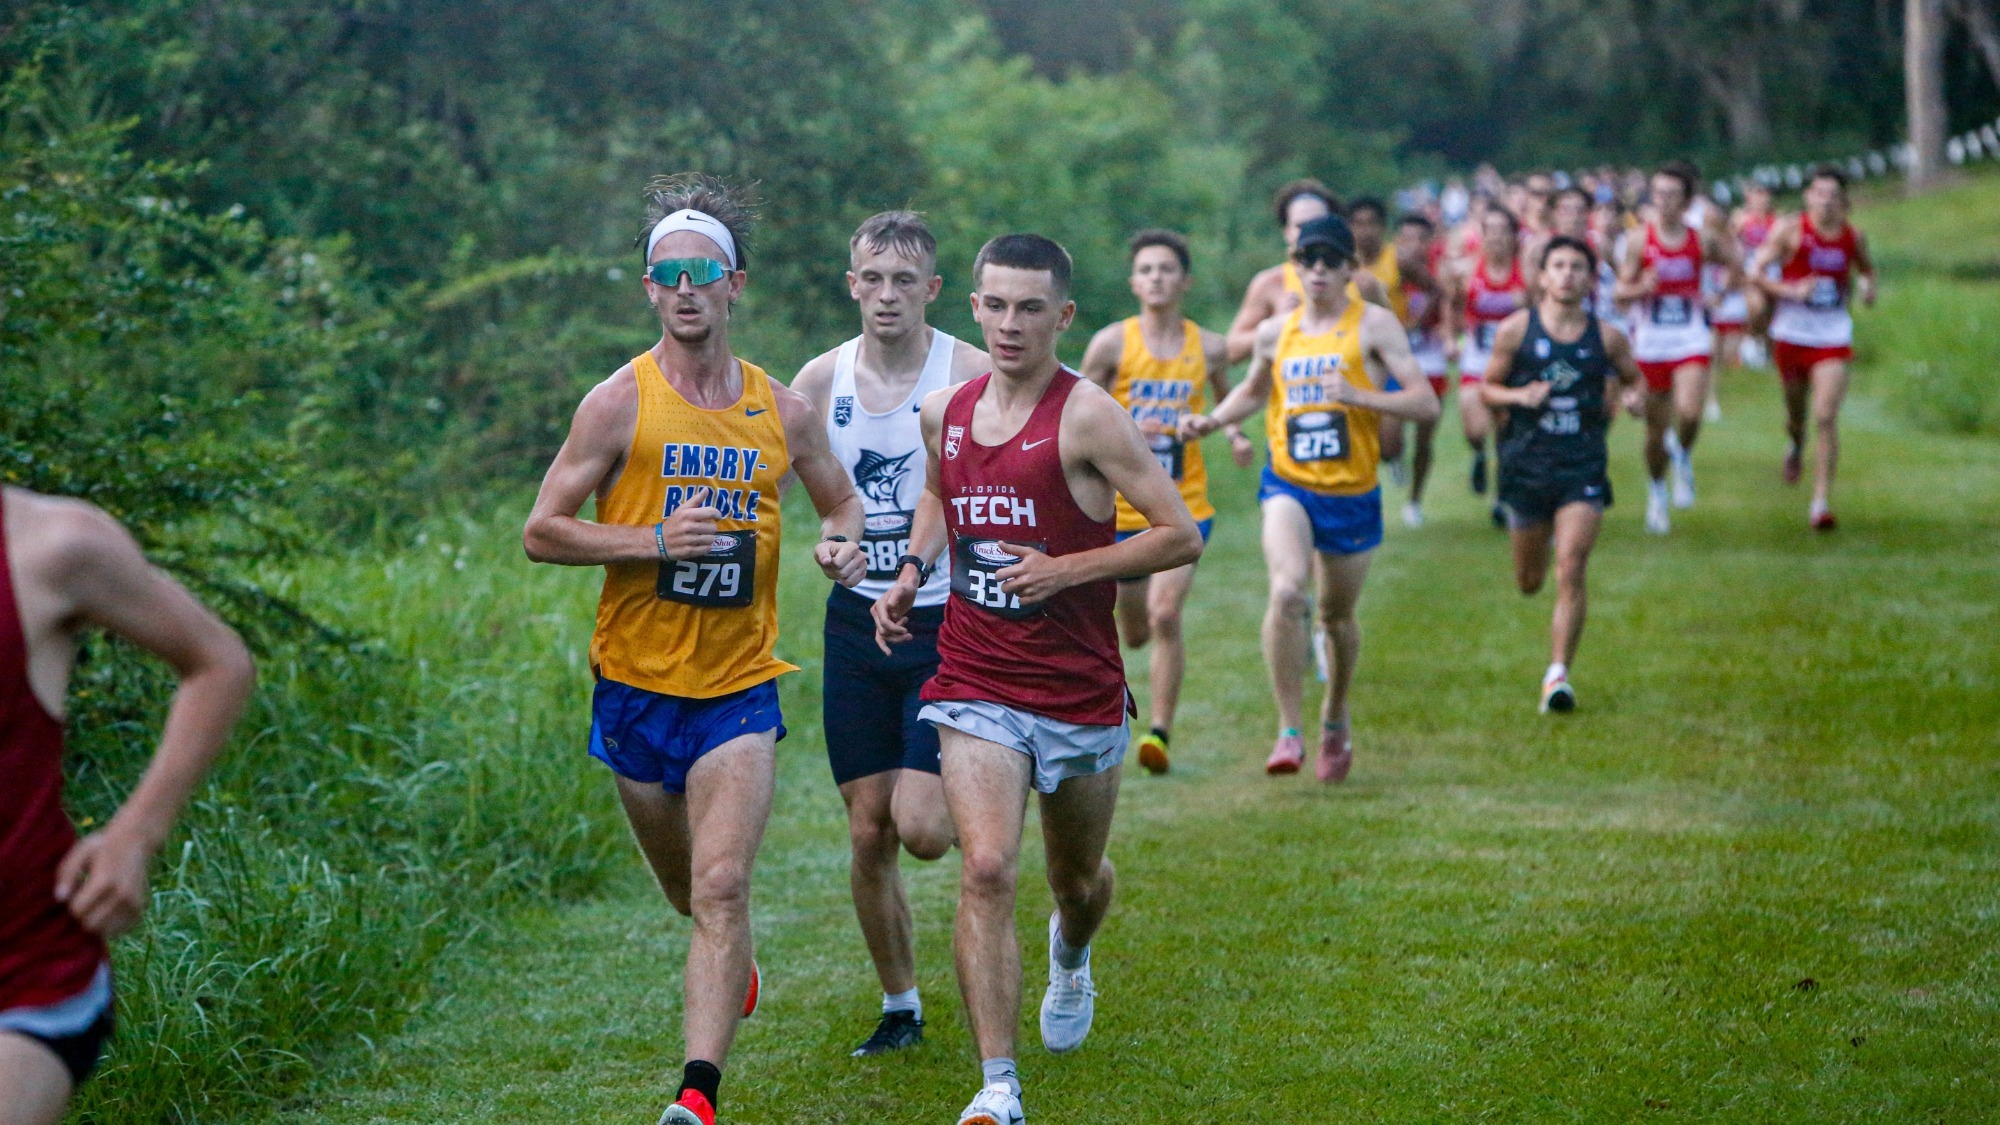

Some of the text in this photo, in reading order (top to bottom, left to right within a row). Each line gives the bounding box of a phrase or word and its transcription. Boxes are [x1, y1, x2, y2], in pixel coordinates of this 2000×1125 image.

[837, 398, 852, 406] SSC
[1294, 429, 1341, 460] 275
[661, 443, 768, 482] EMBRY-
[961, 485, 1016, 495] FLORIDA
[950, 496, 1037, 527] TECH
[974, 544, 995, 555] Track
[673, 560, 741, 597] 279
